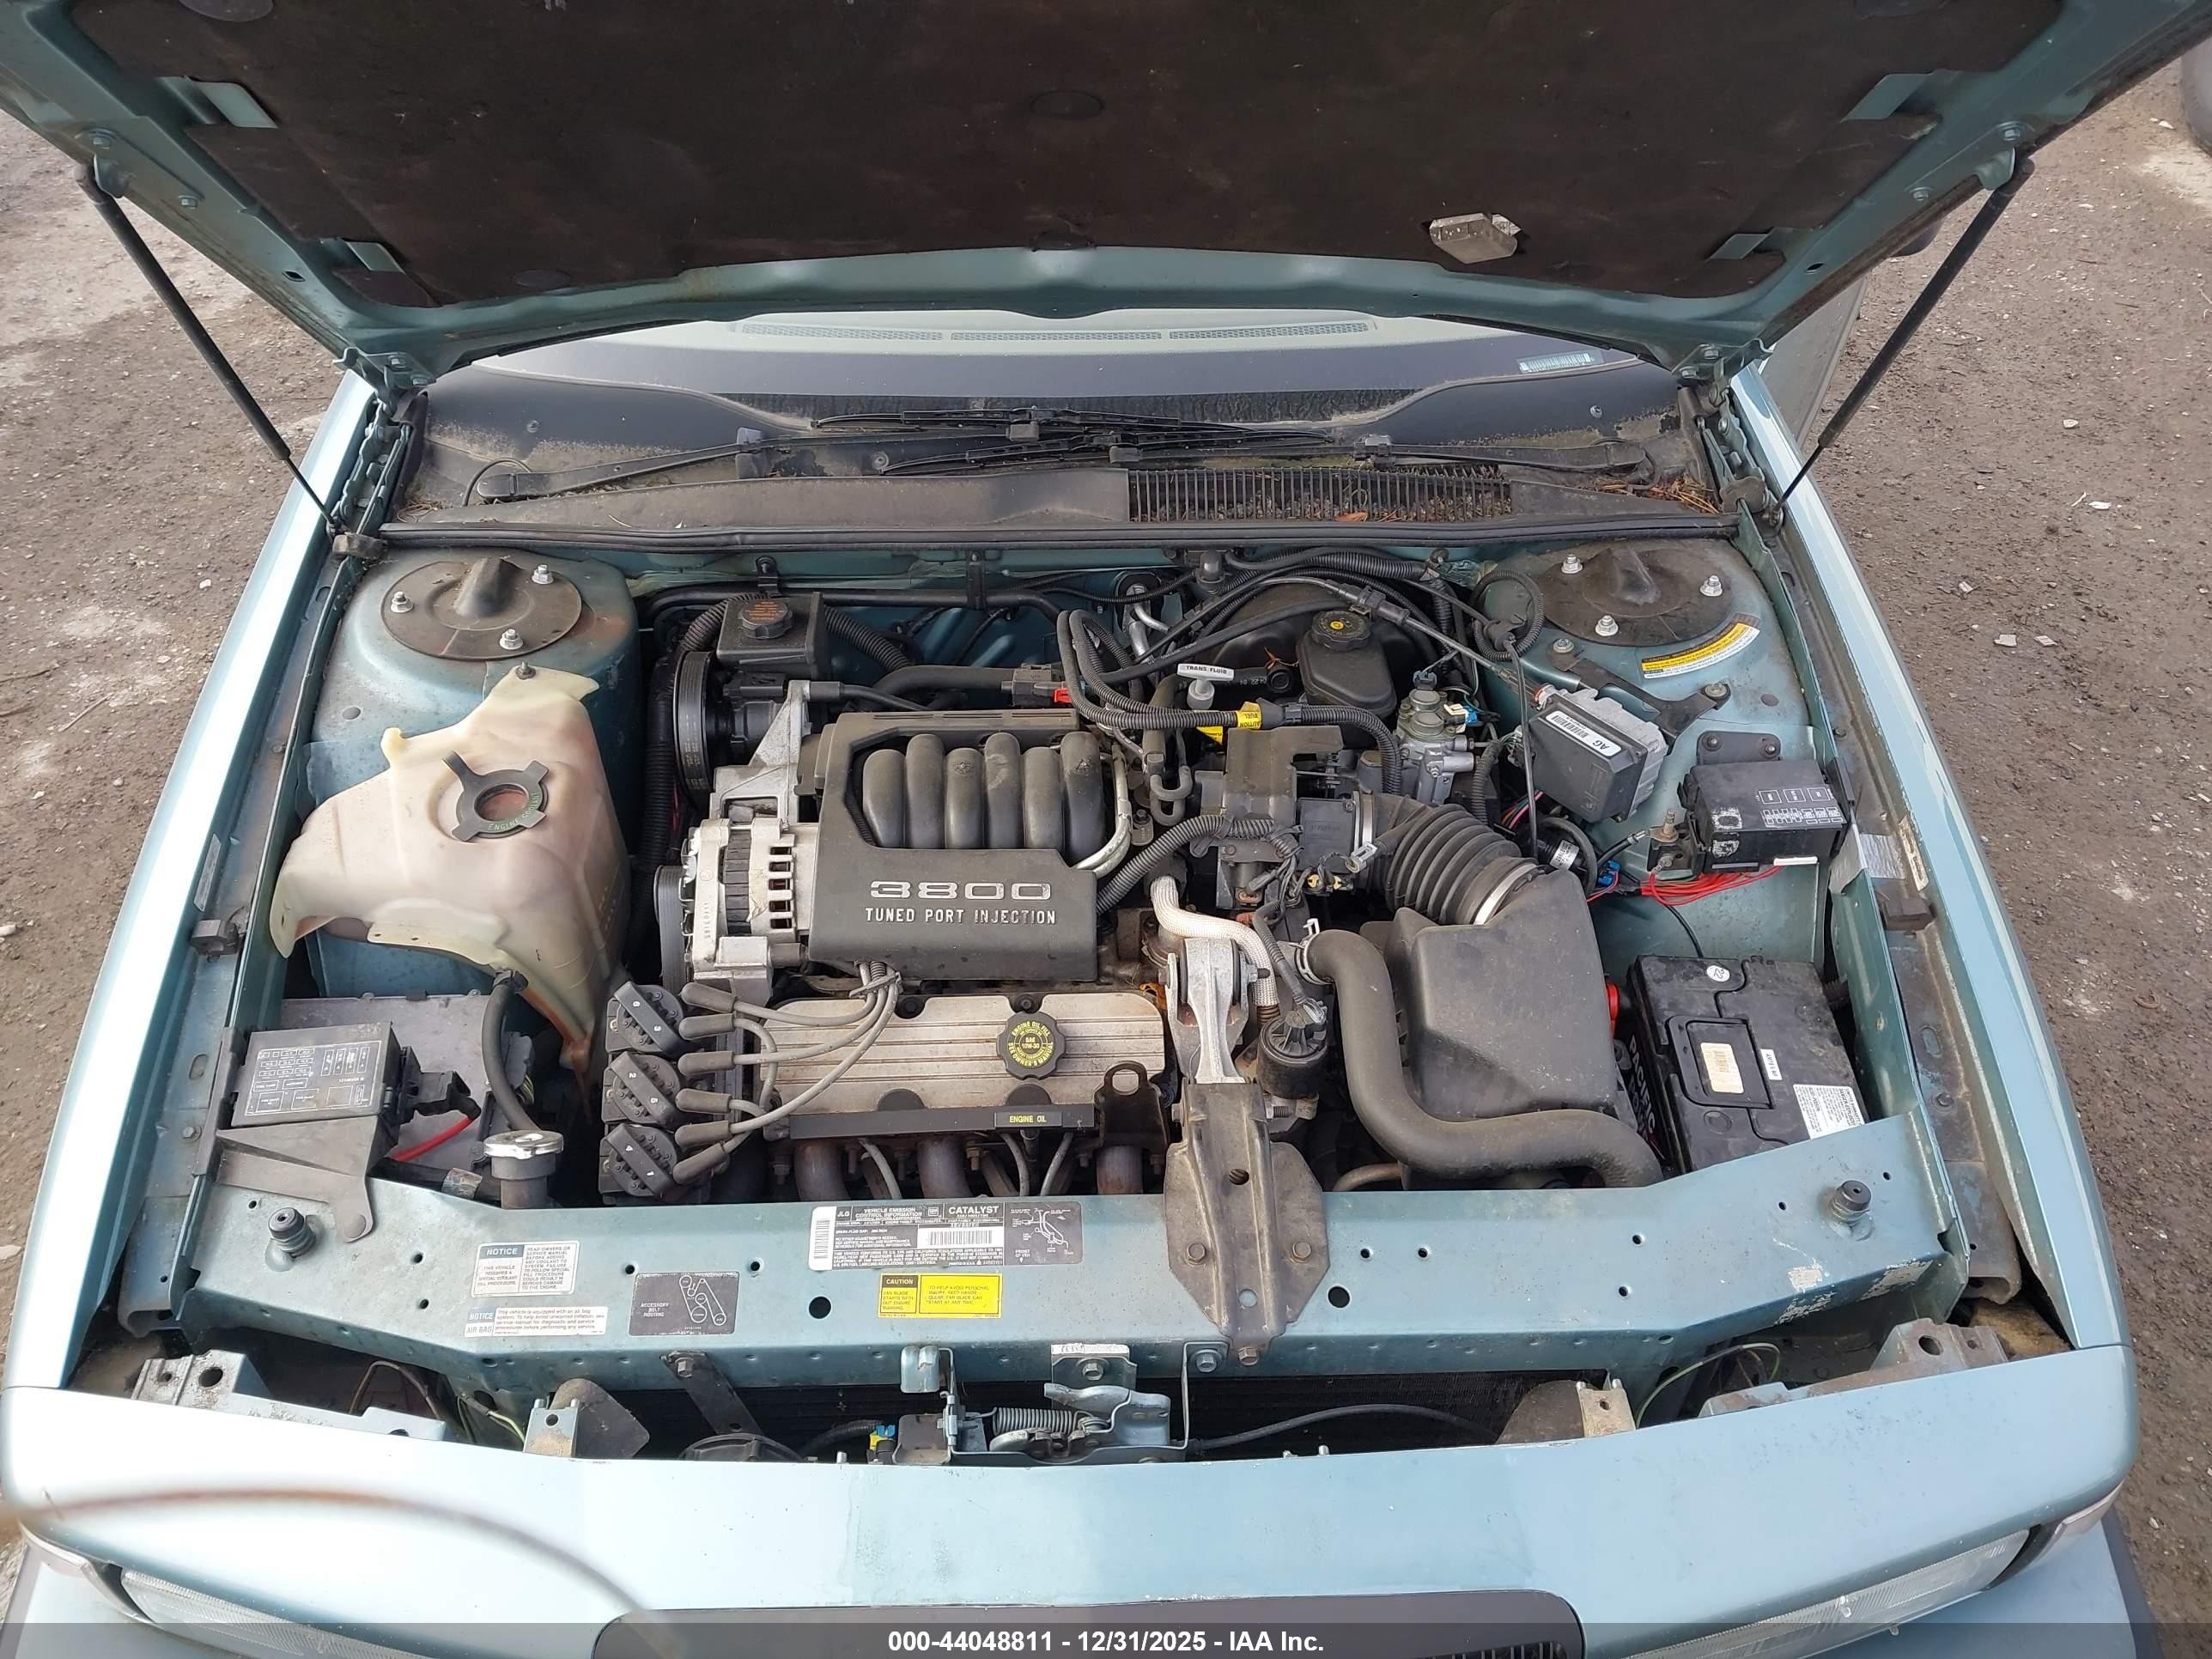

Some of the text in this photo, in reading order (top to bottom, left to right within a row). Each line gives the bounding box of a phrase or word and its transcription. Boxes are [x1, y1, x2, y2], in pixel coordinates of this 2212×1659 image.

[1239, 720, 1261, 729] AUTION
[1591, 738, 1612, 751] AG
[488, 817, 520, 830] ENGINE
[870, 880, 1051, 901] 3800
[866, 908, 1056, 925] TUNED PORT INJECTION
[1012, 1020, 1031, 1036] ENGINE
[1040, 1023, 1051, 1037] FILL
[1012, 1053, 1038, 1066] OWNER'S
[1038, 1041, 1054, 1064] MANUAL
[1630, 1035, 1656, 1133] PACIFIC
[948, 1206, 1000, 1214] CATALYST
[486, 1248, 519, 1256] NOTICE
[468, 1311, 495, 1321] NOTICE
